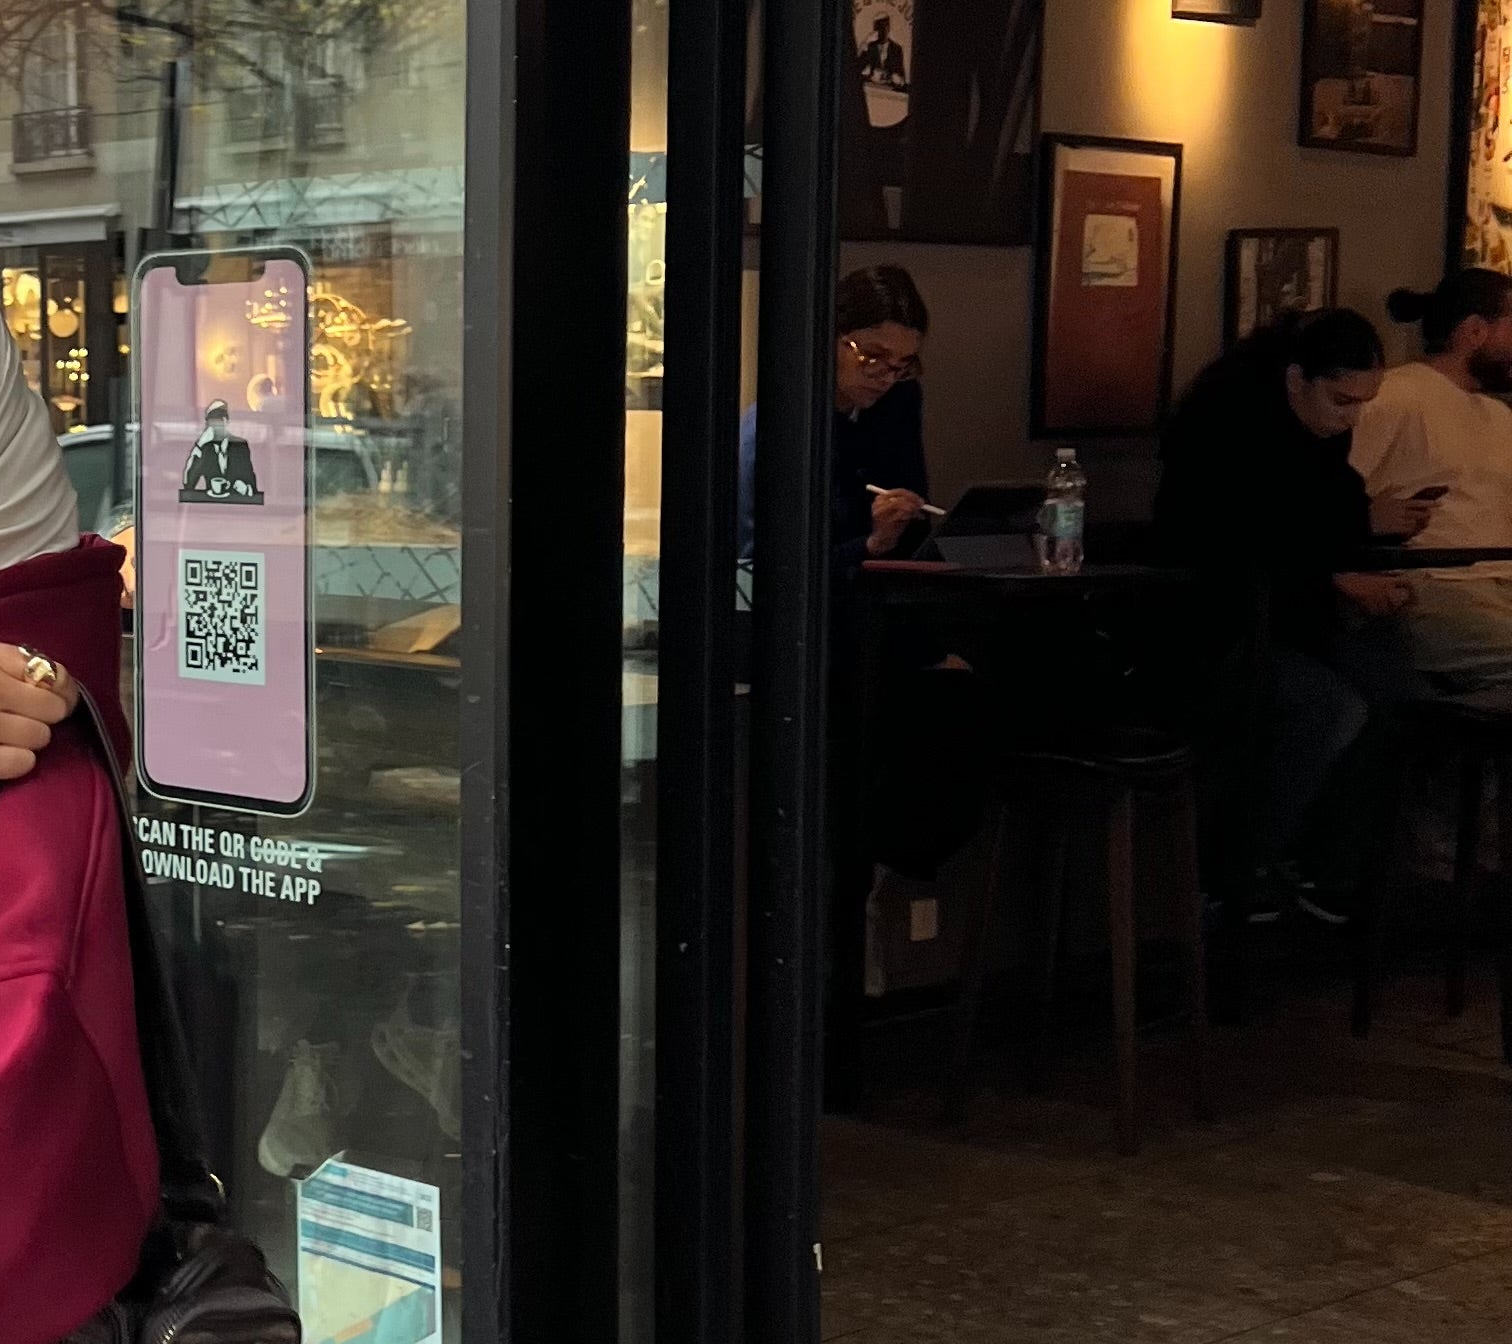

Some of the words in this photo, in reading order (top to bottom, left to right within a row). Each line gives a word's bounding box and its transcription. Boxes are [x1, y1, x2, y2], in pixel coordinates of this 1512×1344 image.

[132, 814, 176, 847] CAN
[179, 824, 215, 854] THE
[219, 831, 245, 860] QR
[250, 836, 302, 870] CODE
[305, 845, 323, 873] &
[141, 848, 235, 889] OWNLOAD
[239, 866, 276, 898] THE
[279, 874, 322, 905] APP
